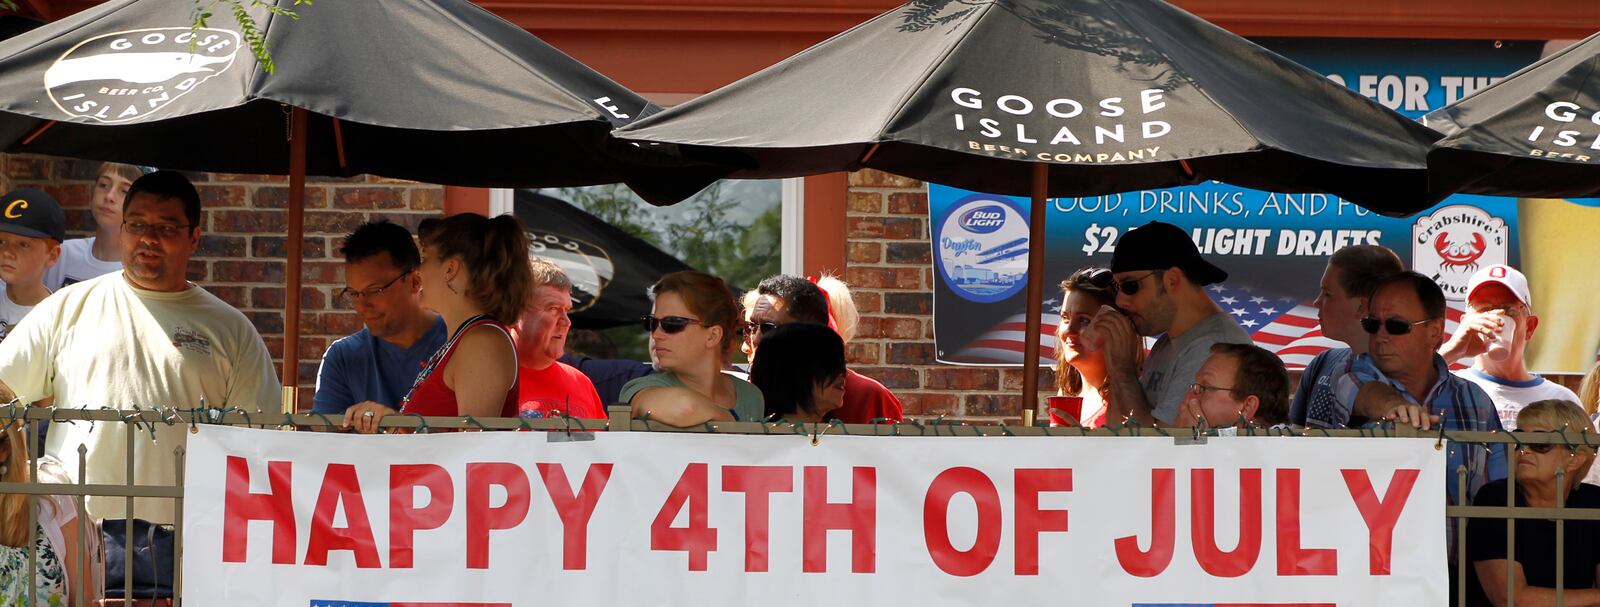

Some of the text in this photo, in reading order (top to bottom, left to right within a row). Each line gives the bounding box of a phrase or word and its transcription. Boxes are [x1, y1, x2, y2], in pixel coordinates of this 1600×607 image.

[110, 33, 230, 53] GOOSE
[63, 78, 196, 118] ISLAND
[99, 87, 138, 96] BEER
[951, 87, 1166, 118] GOOSE
[1360, 75, 1429, 111] FOR
[955, 114, 1171, 145] ISLAND
[968, 141, 1161, 163] BEER COMPANY
[4, 199, 29, 219] C
[973, 211, 1001, 219] BUD
[1046, 193, 1128, 216] OOD,
[1140, 190, 1249, 218] DRINKS,
[1258, 192, 1327, 216] AND
[966, 219, 1004, 227] LIGHT
[1418, 213, 1503, 246] Crabshire's
[1192, 227, 1273, 255] LIGHT
[1277, 229, 1382, 256] DRAFTS
[222, 455, 1421, 578] HAPPY 4TH OF JULY
